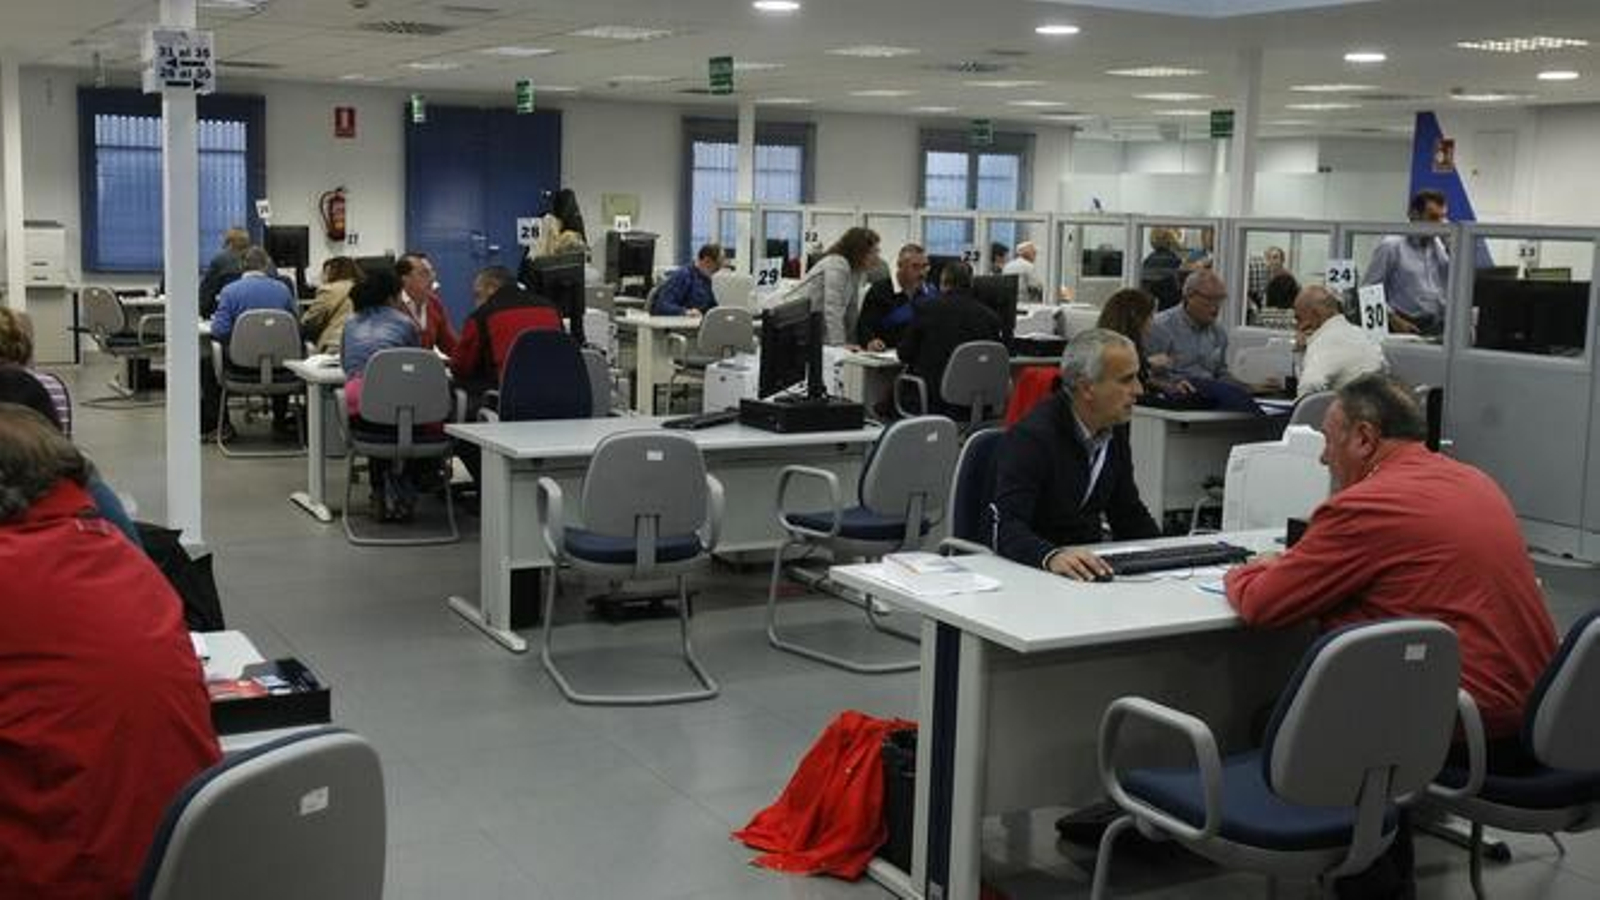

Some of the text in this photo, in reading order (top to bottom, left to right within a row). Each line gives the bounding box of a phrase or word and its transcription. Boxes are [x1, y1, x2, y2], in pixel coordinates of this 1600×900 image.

[521, 225, 540, 239] 28
[757, 267, 779, 286] 29
[1329, 267, 1351, 282] 24
[1365, 303, 1384, 329] 30
